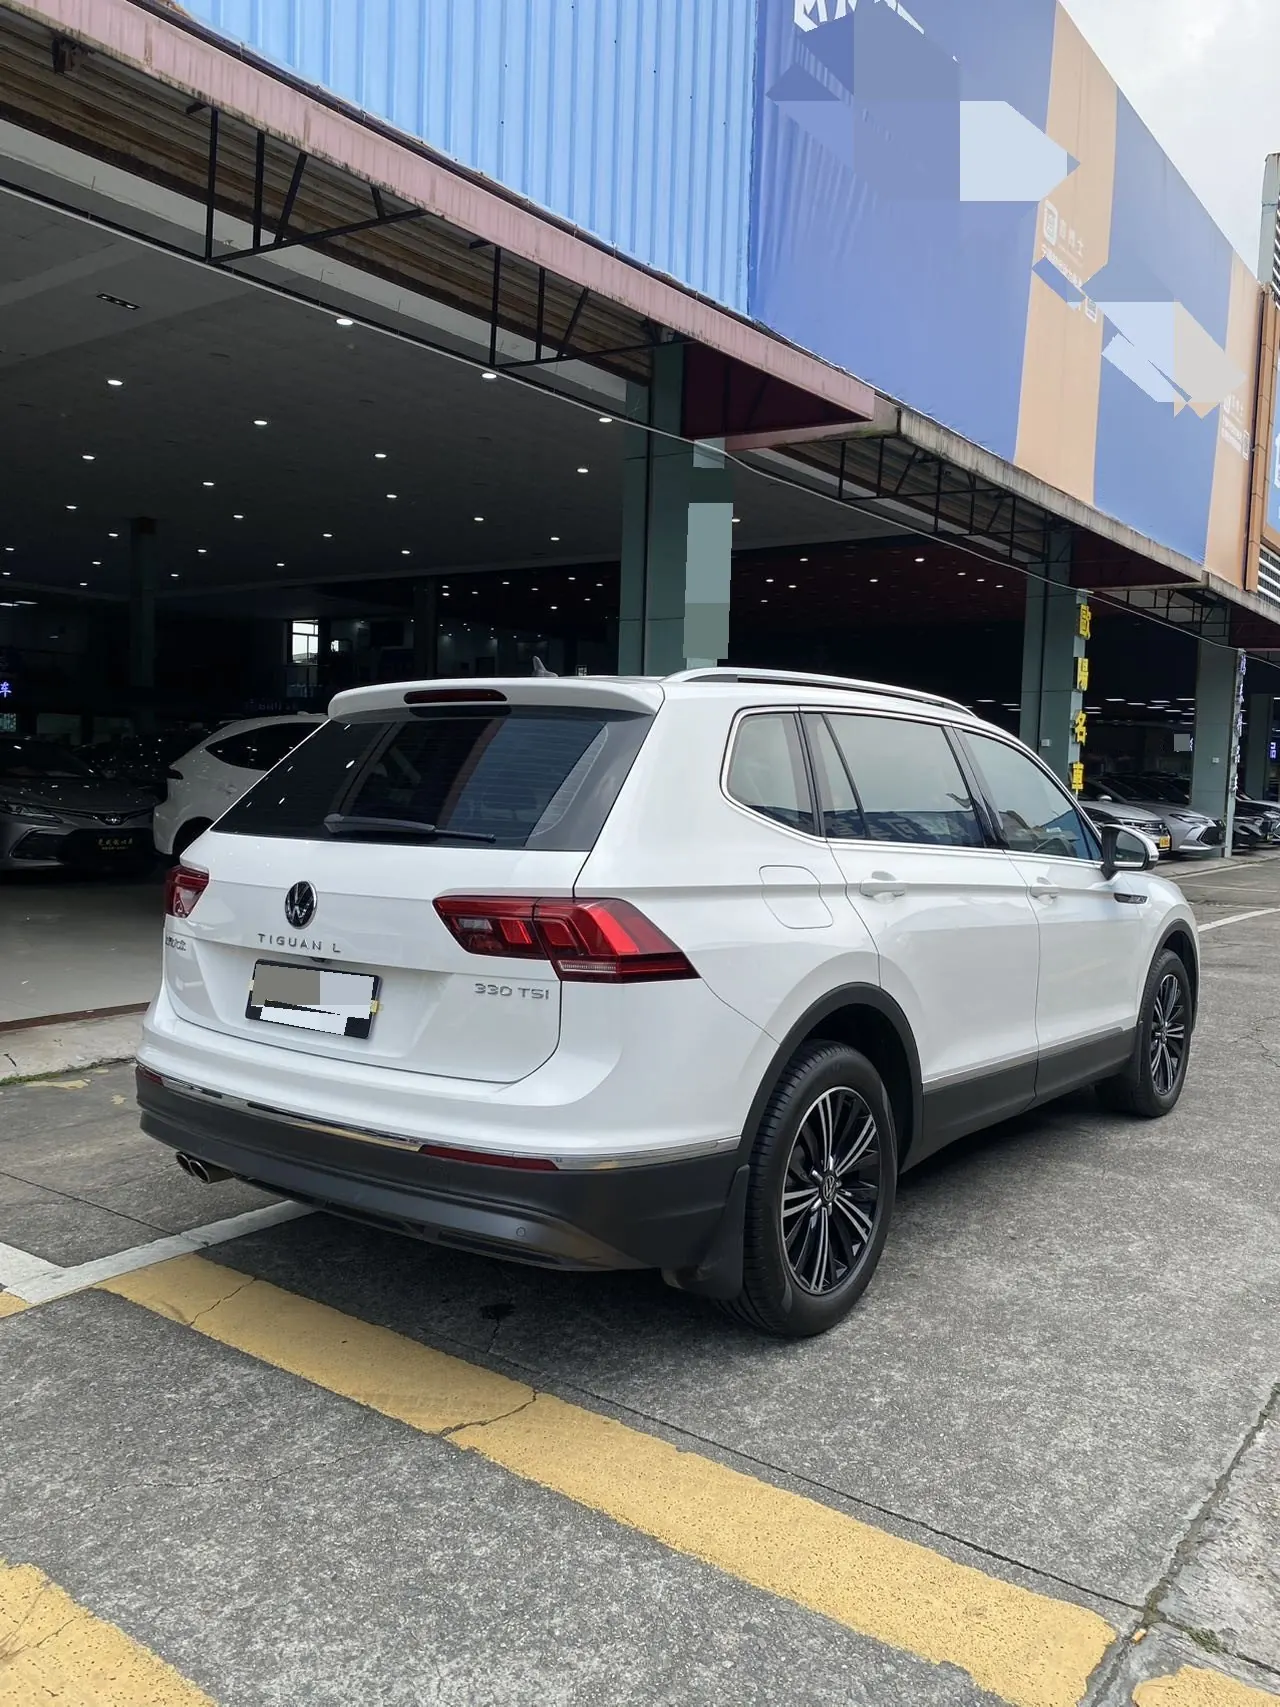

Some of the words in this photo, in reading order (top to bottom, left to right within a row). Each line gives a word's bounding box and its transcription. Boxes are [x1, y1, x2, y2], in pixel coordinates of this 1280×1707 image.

[257, 933, 322, 951] TIGUAN
[332, 943, 341, 953] L
[474, 982, 513, 997] 330
[517, 986, 550, 1000] TSI
